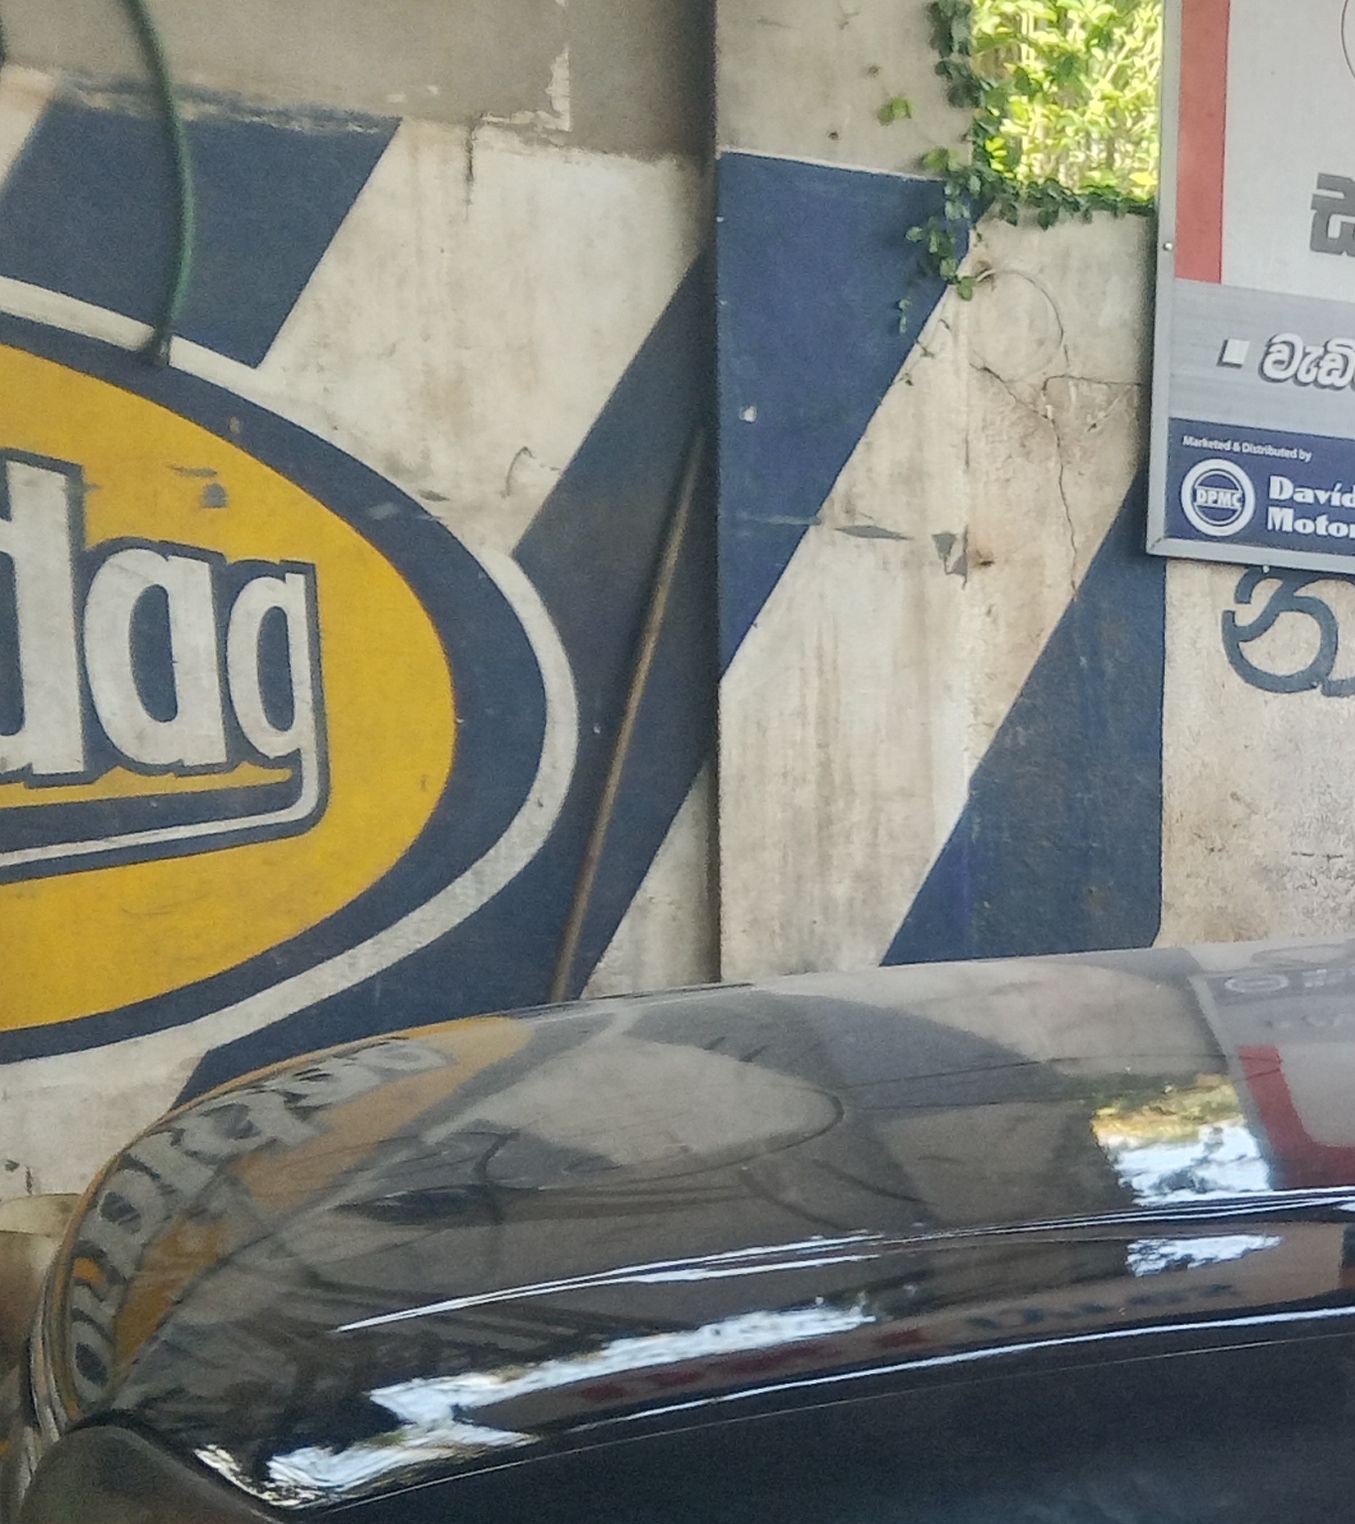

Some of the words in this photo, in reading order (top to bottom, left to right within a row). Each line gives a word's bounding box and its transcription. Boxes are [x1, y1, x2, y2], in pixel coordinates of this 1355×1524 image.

[1183, 435, 1231, 452] Marketed
[1242, 443, 1297, 460] Distributed
[1299, 449, 1313, 463] by
[1195, 487, 1244, 509] DPMC
